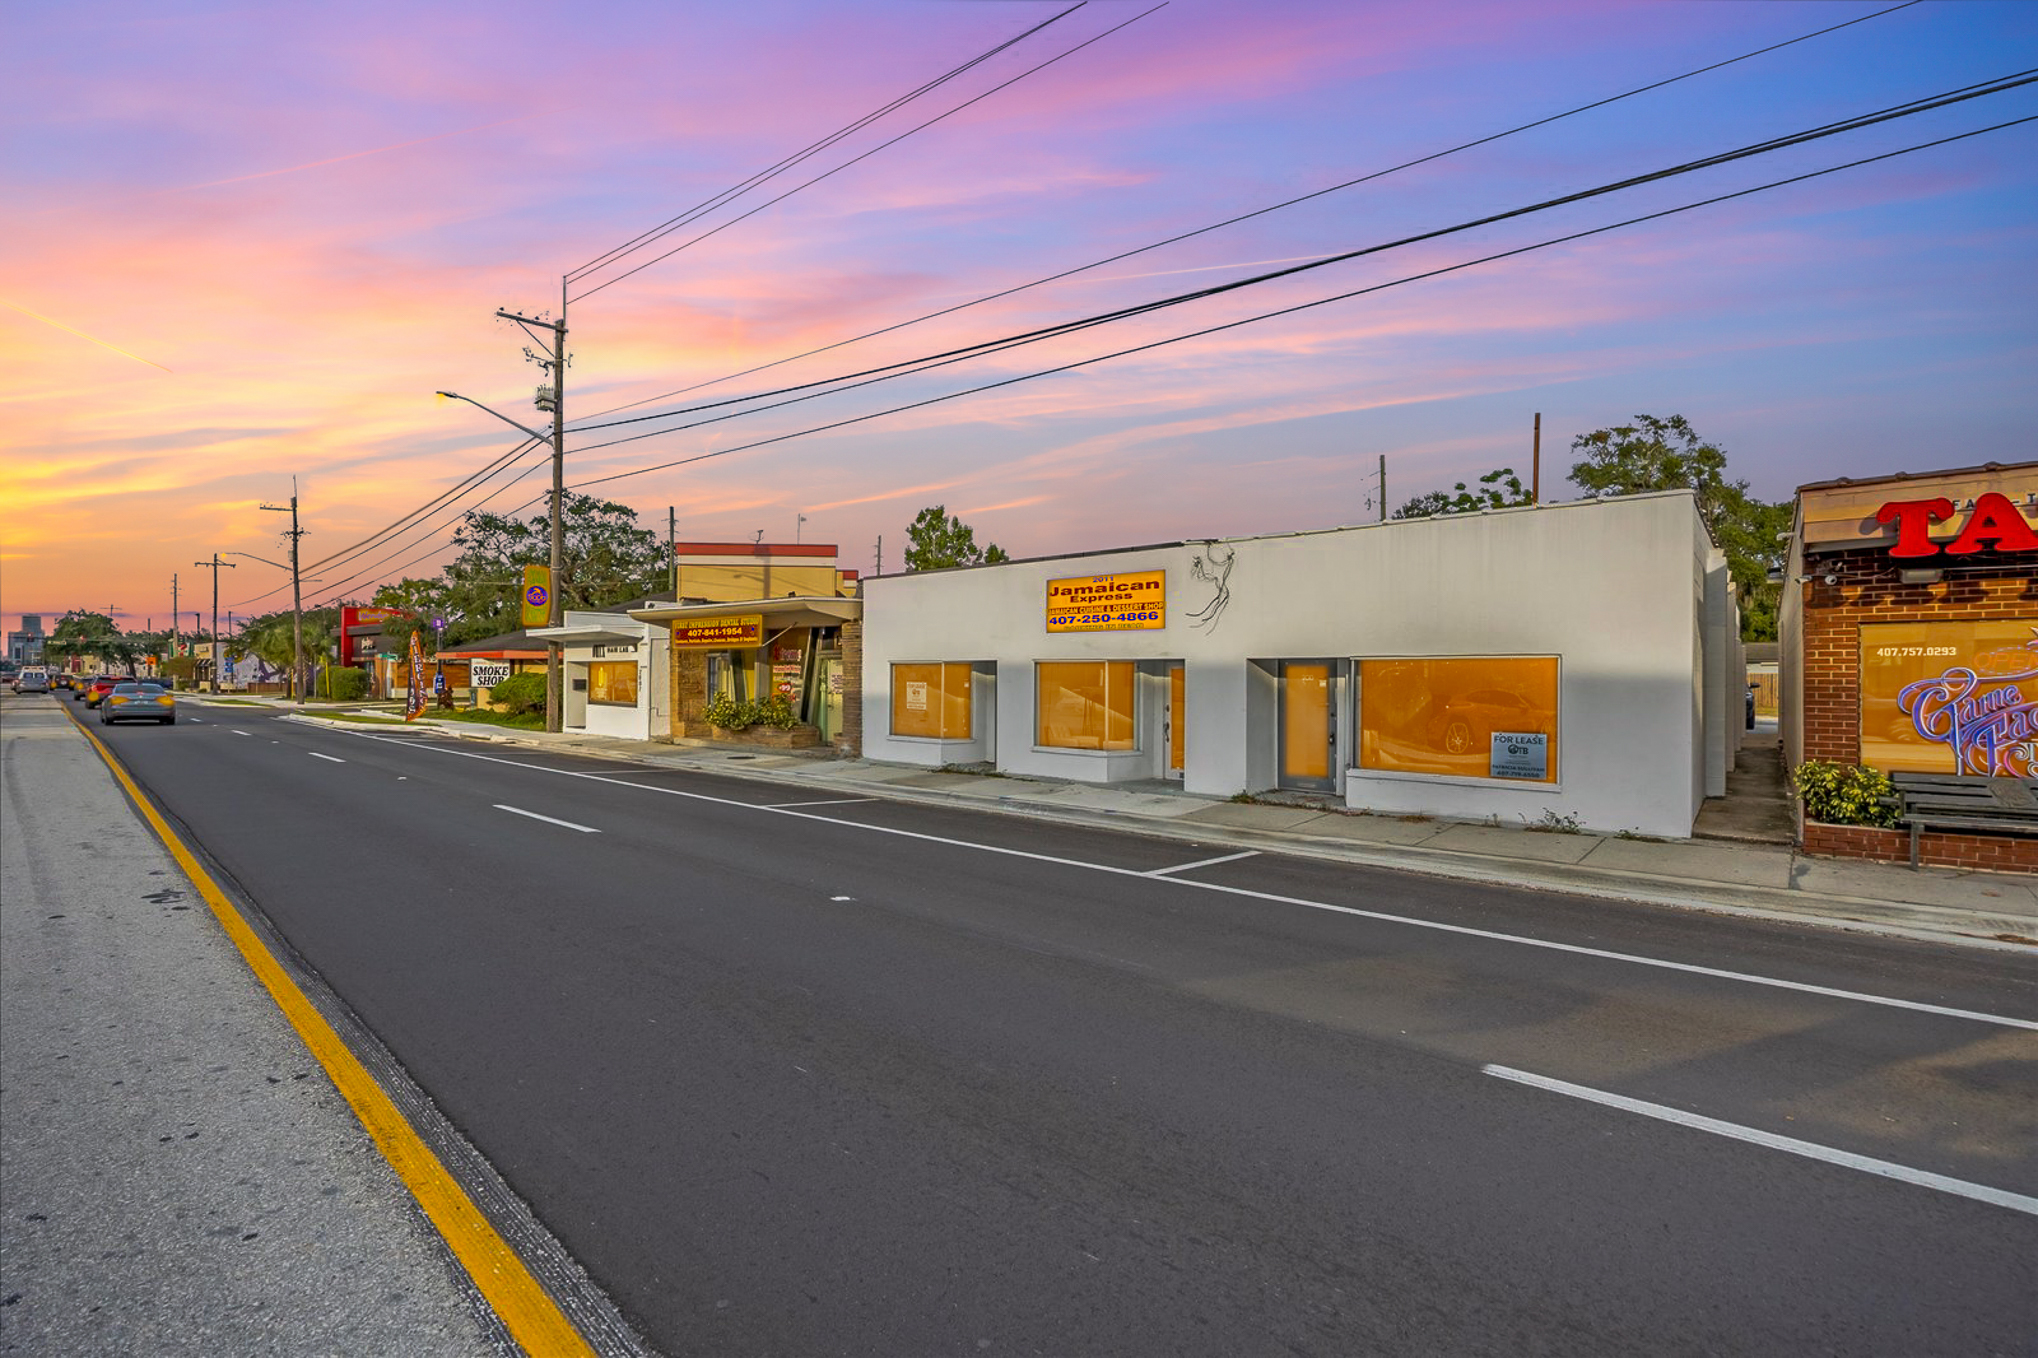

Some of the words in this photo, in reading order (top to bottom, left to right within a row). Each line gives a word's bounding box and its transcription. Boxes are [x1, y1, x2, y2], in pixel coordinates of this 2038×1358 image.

[1049, 581, 1160, 597] Jamaican
[1070, 593, 1133, 603] Express
[1143, 601, 1164, 610] SHOP
[688, 627, 742, 637] 407-841-1954
[1877, 647, 1957, 657] 407.757.0293
[473, 666, 508, 676] SMOKE
[1494, 735, 1513, 743] FOR
[1515, 735, 1543, 745] LEASE
